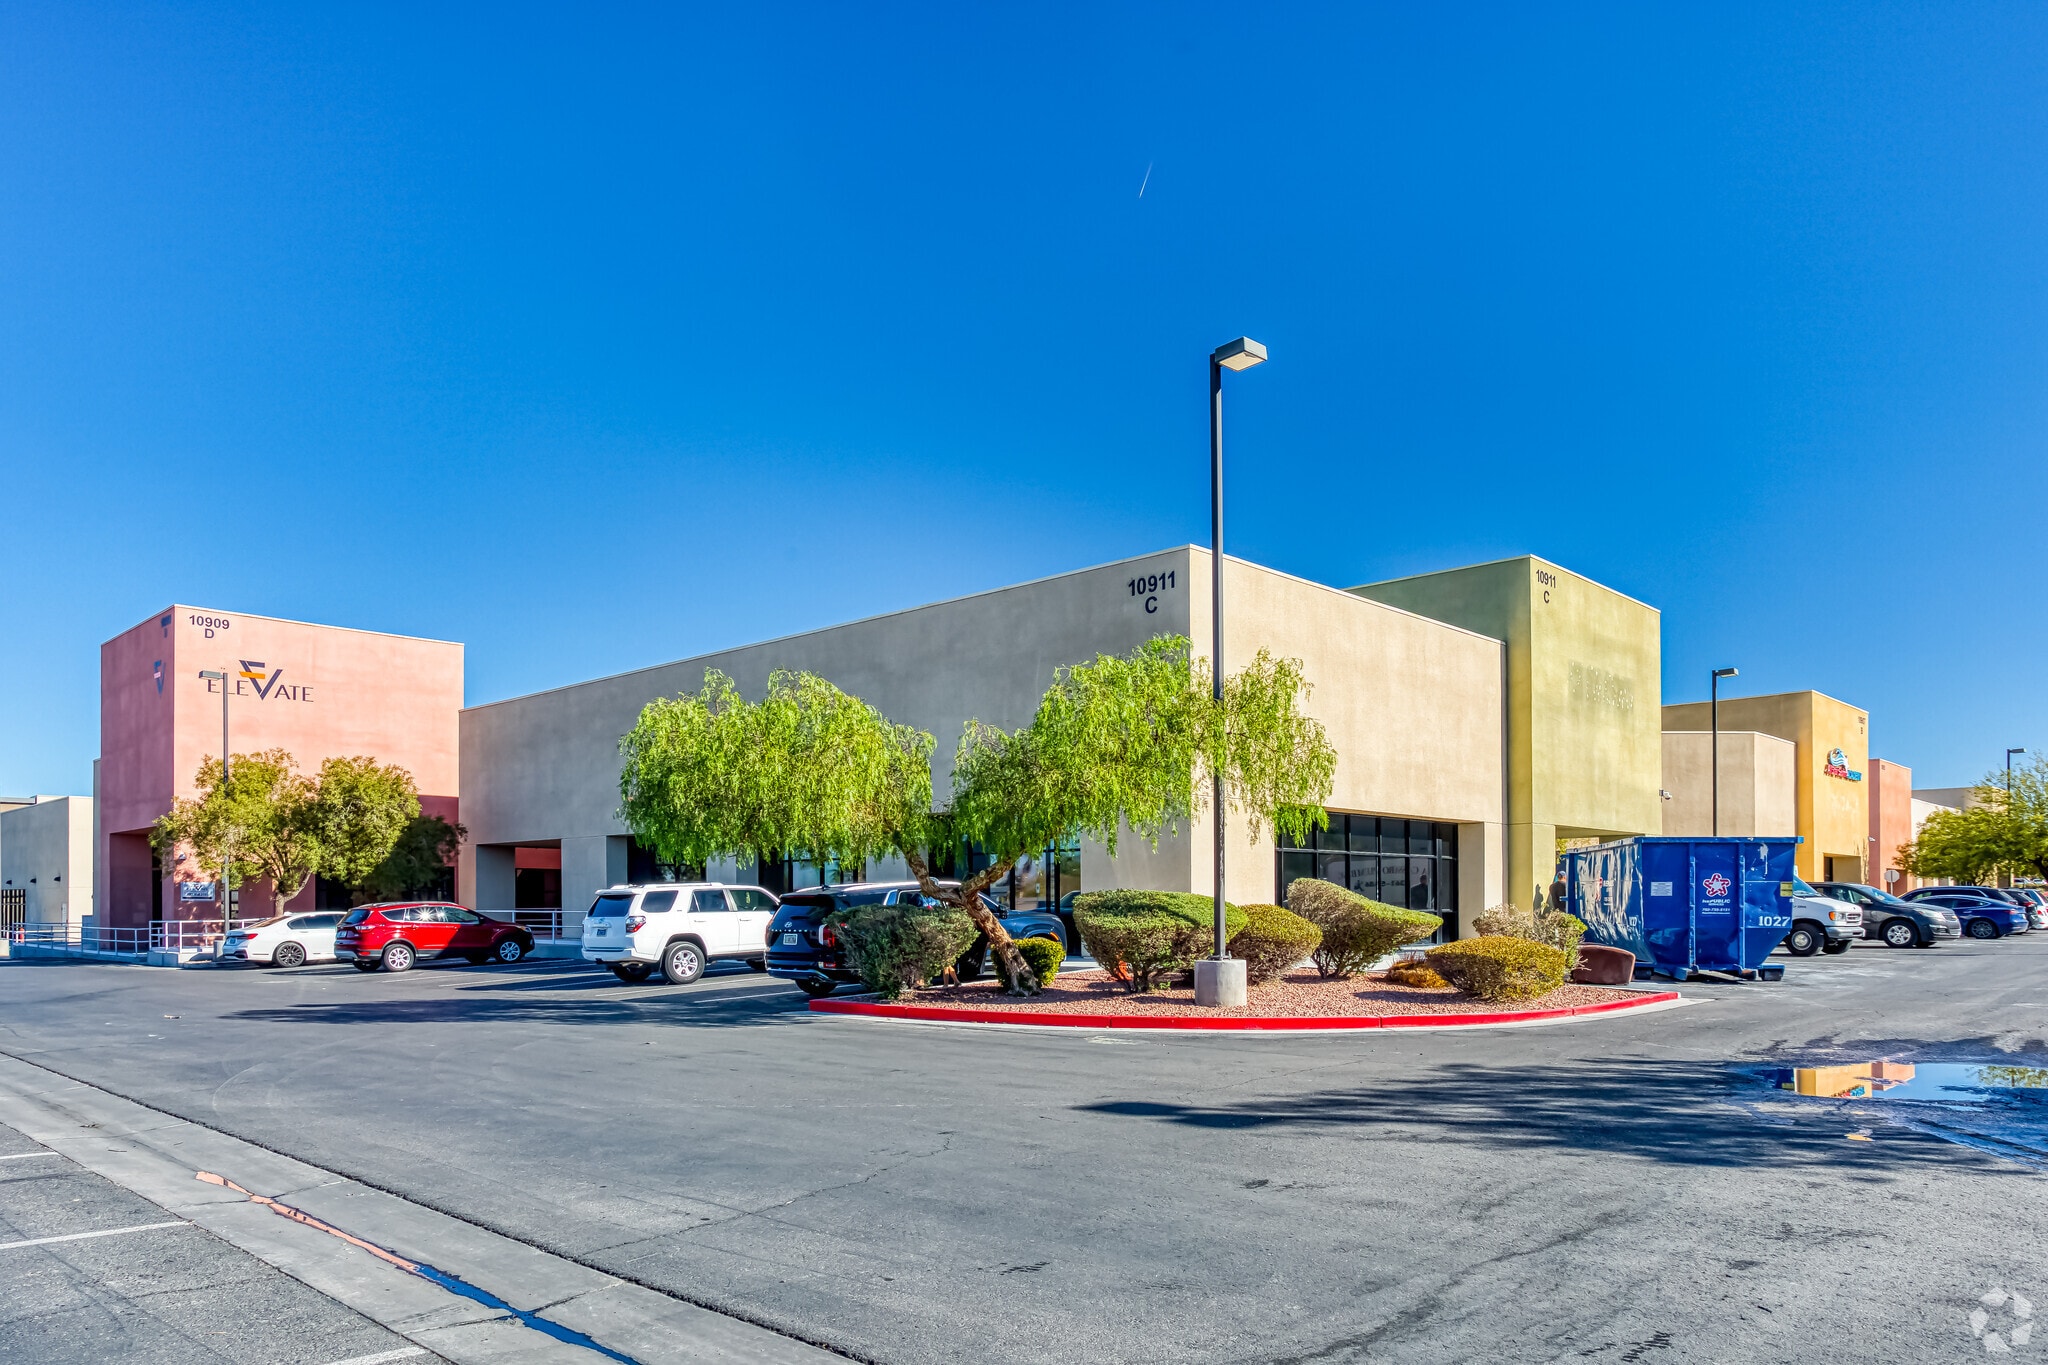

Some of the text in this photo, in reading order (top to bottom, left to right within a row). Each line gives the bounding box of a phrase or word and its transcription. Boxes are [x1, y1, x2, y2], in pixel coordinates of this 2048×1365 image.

[1128, 570, 1175, 596] 10911
[1536, 569, 1556, 588] 10911
[1543, 590, 1550, 604] C
[1145, 596, 1158, 614] C
[189, 615, 230, 630] 10909
[204, 628, 215, 639] D
[1758, 916, 1790, 927] 1027
